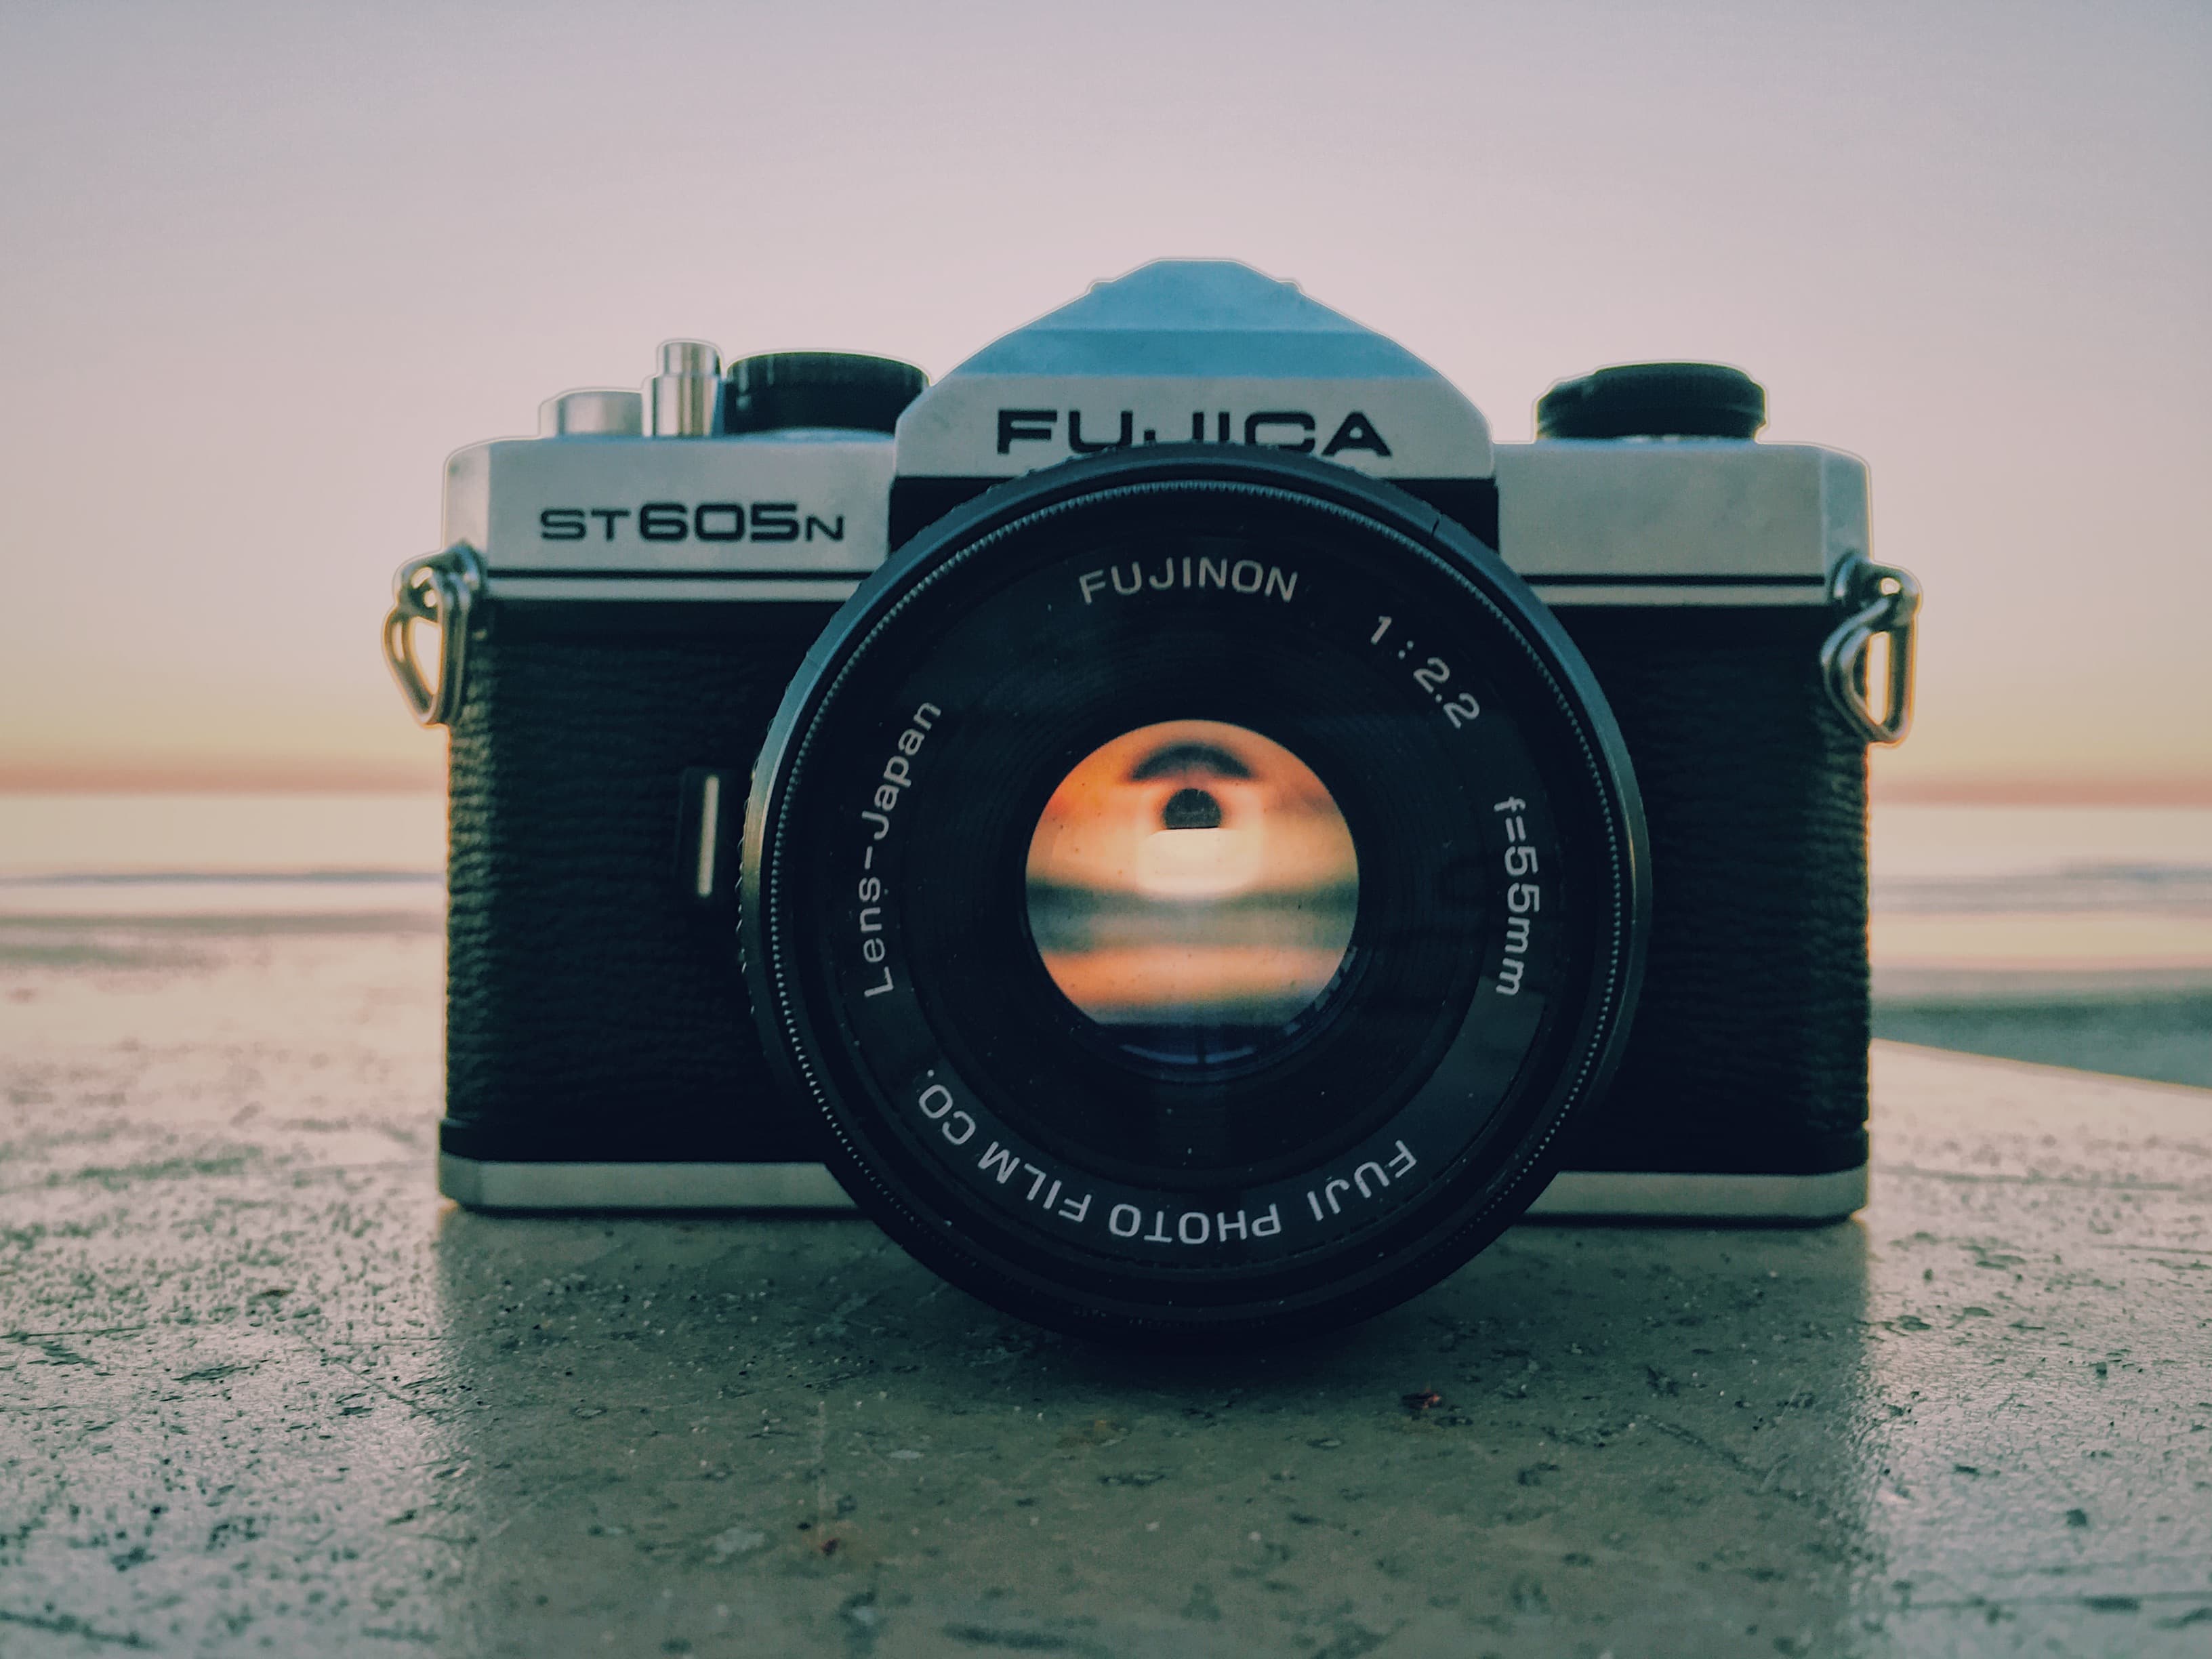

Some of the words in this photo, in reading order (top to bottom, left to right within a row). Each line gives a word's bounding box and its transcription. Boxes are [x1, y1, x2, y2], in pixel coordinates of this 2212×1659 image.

[997, 409, 1392, 457] FUJICA
[539, 502, 845, 542] ST605N
[1079, 557, 1298, 604] FUJINON
[859, 702, 942, 998] Lens-Japan
[1493, 796, 1540, 996] f=55mm
[918, 1069, 977, 1146] CO.
[977, 1141, 1092, 1223] FILM
[1306, 1140, 1418, 1222] FUJI
[1109, 1203, 1282, 1244] PHOTO
